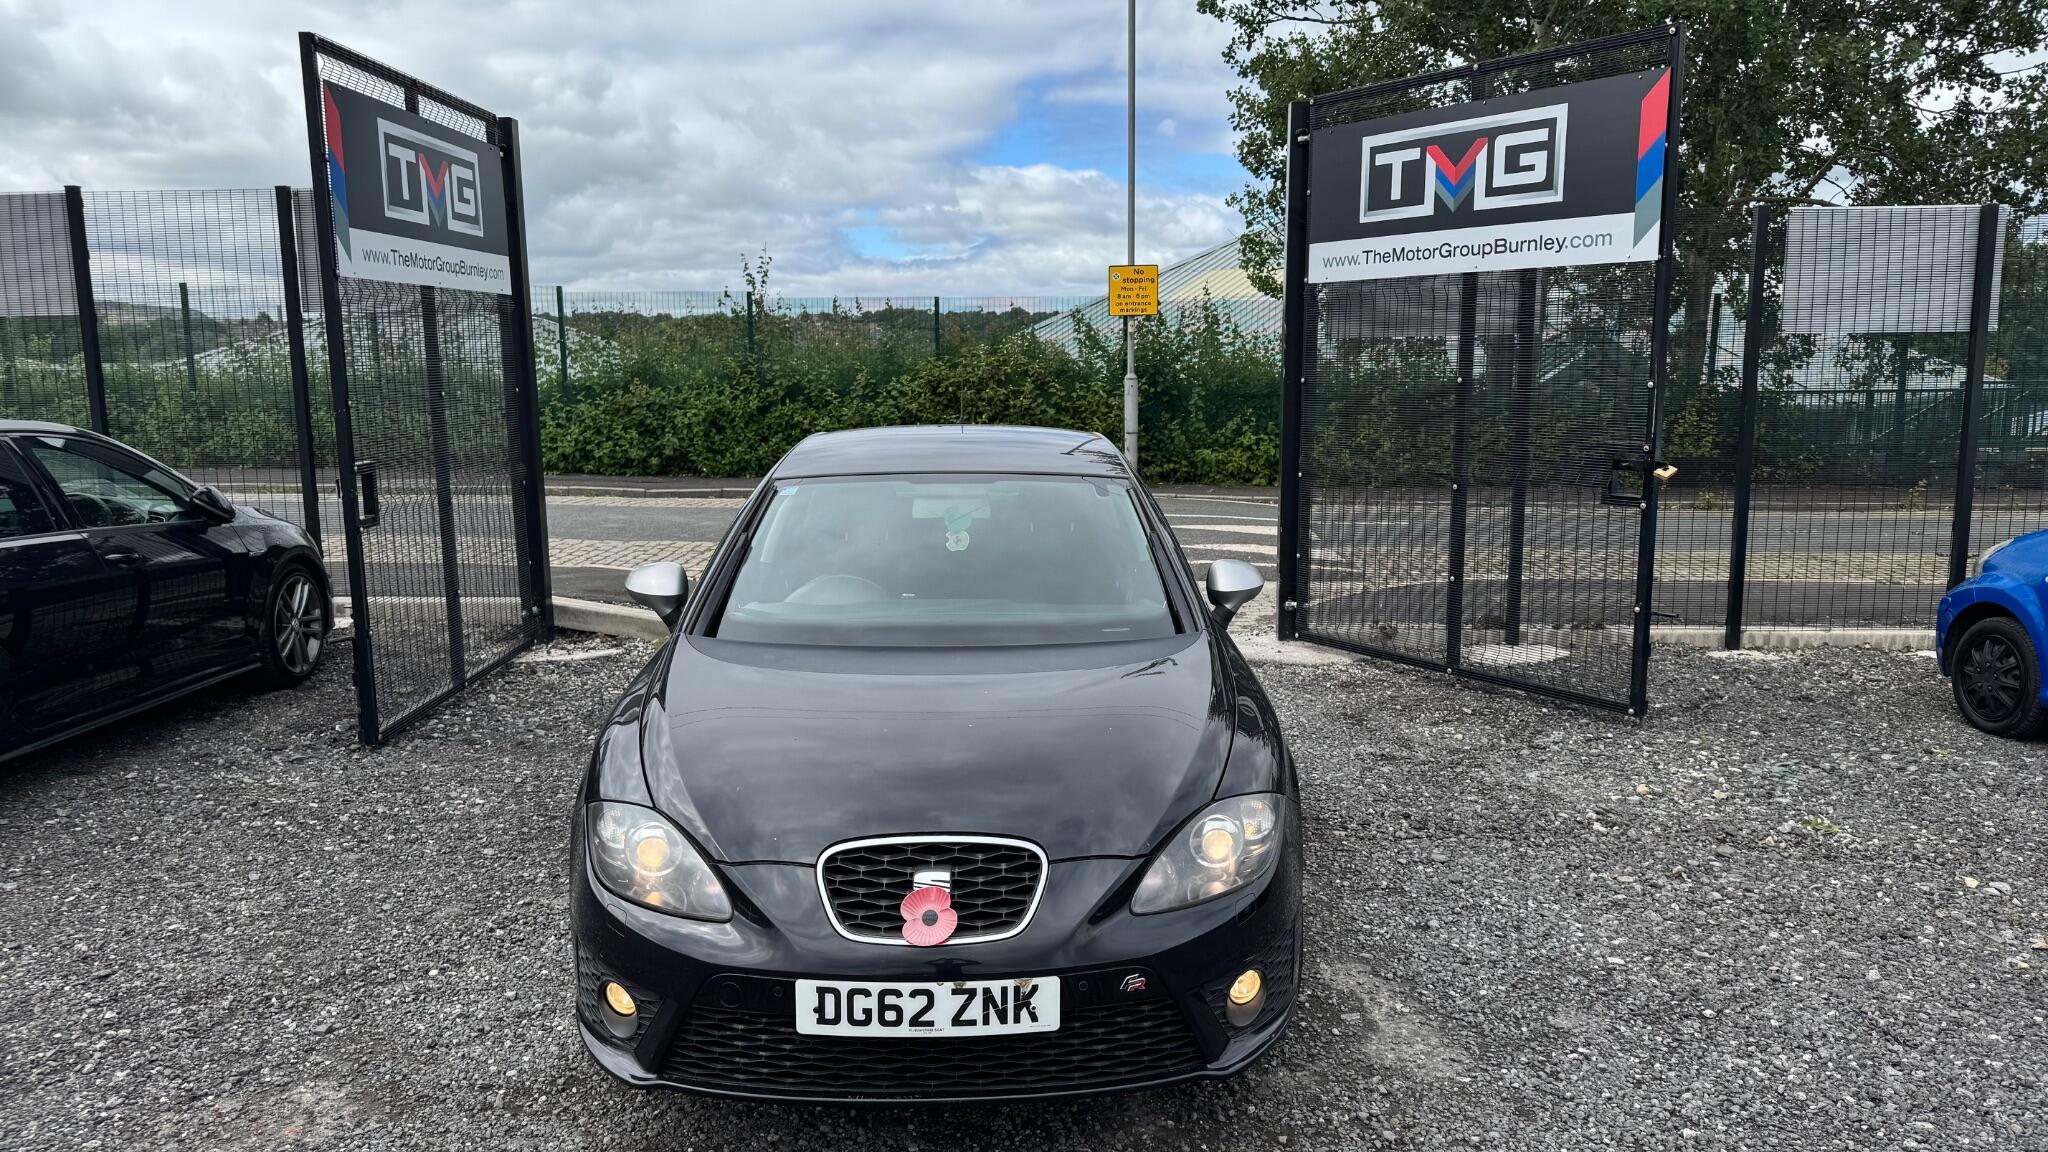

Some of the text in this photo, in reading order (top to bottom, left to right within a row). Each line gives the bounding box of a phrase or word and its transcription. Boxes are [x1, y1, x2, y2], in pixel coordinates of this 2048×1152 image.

[388, 142, 476, 228] TMG
[1375, 127, 1549, 213] TMG
[361, 248, 505, 281] www.TheMotorGroupBurnley.com
[1322, 231, 1613, 268] www.TheMotorGroupBurnley.com
[815, 984, 1039, 1028] DG62 ZNK
